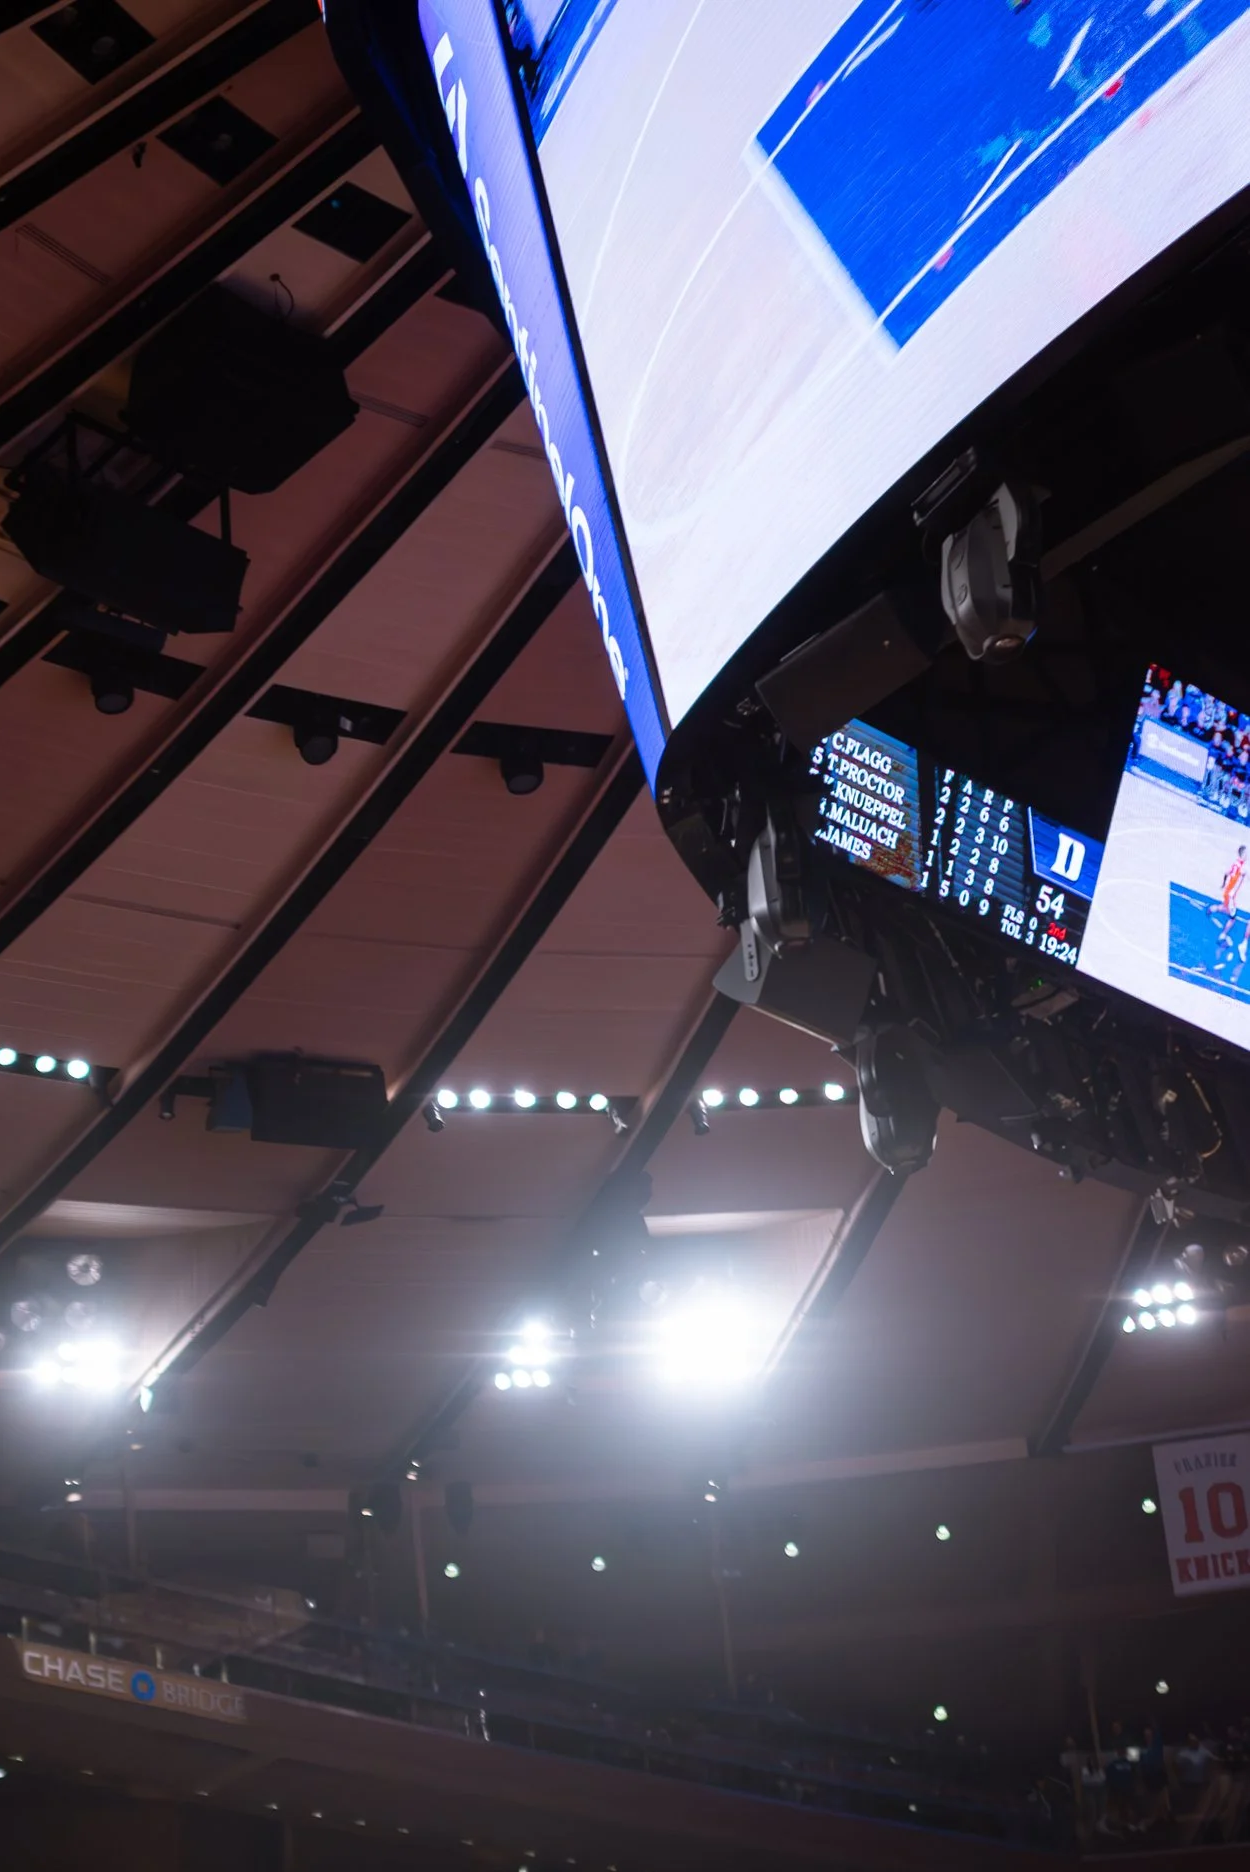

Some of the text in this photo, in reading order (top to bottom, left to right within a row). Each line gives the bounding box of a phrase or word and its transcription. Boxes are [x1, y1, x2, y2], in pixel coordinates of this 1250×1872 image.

[827, 753, 905, 805] T.PROCTOR
[934, 808, 945, 824] 2
[955, 818, 965, 834] 2
[975, 828, 985, 843] 3
[992, 836, 1008, 855] 10
[832, 732, 1009, 833] C.FLAGG 2 2 6 6
[944, 770, 1013, 813] F A R P
[926, 851, 933, 867] 1
[946, 860, 954, 876] 1
[964, 870, 974, 886] 3
[984, 879, 994, 896] 8
[931, 830, 939, 846] 1
[949, 838, 960, 855] 2
[969, 849, 980, 865] 2
[989, 858, 999, 875] 8
[1050, 833, 1086, 882] D
[921, 872, 928, 888] 1
[939, 881, 950, 897] 5
[959, 890, 969, 906] 0
[979, 899, 989, 916] 9
[1036, 886, 1065, 920] 54
[1001, 920, 1034, 945] TOL 3
[1003, 905, 1038, 930] FLS 0
[1039, 934, 1077, 964] 19:24
[1178, 1481, 1249, 1544] 10
[23, 1651, 246, 1718] CHASE BRIDGE
